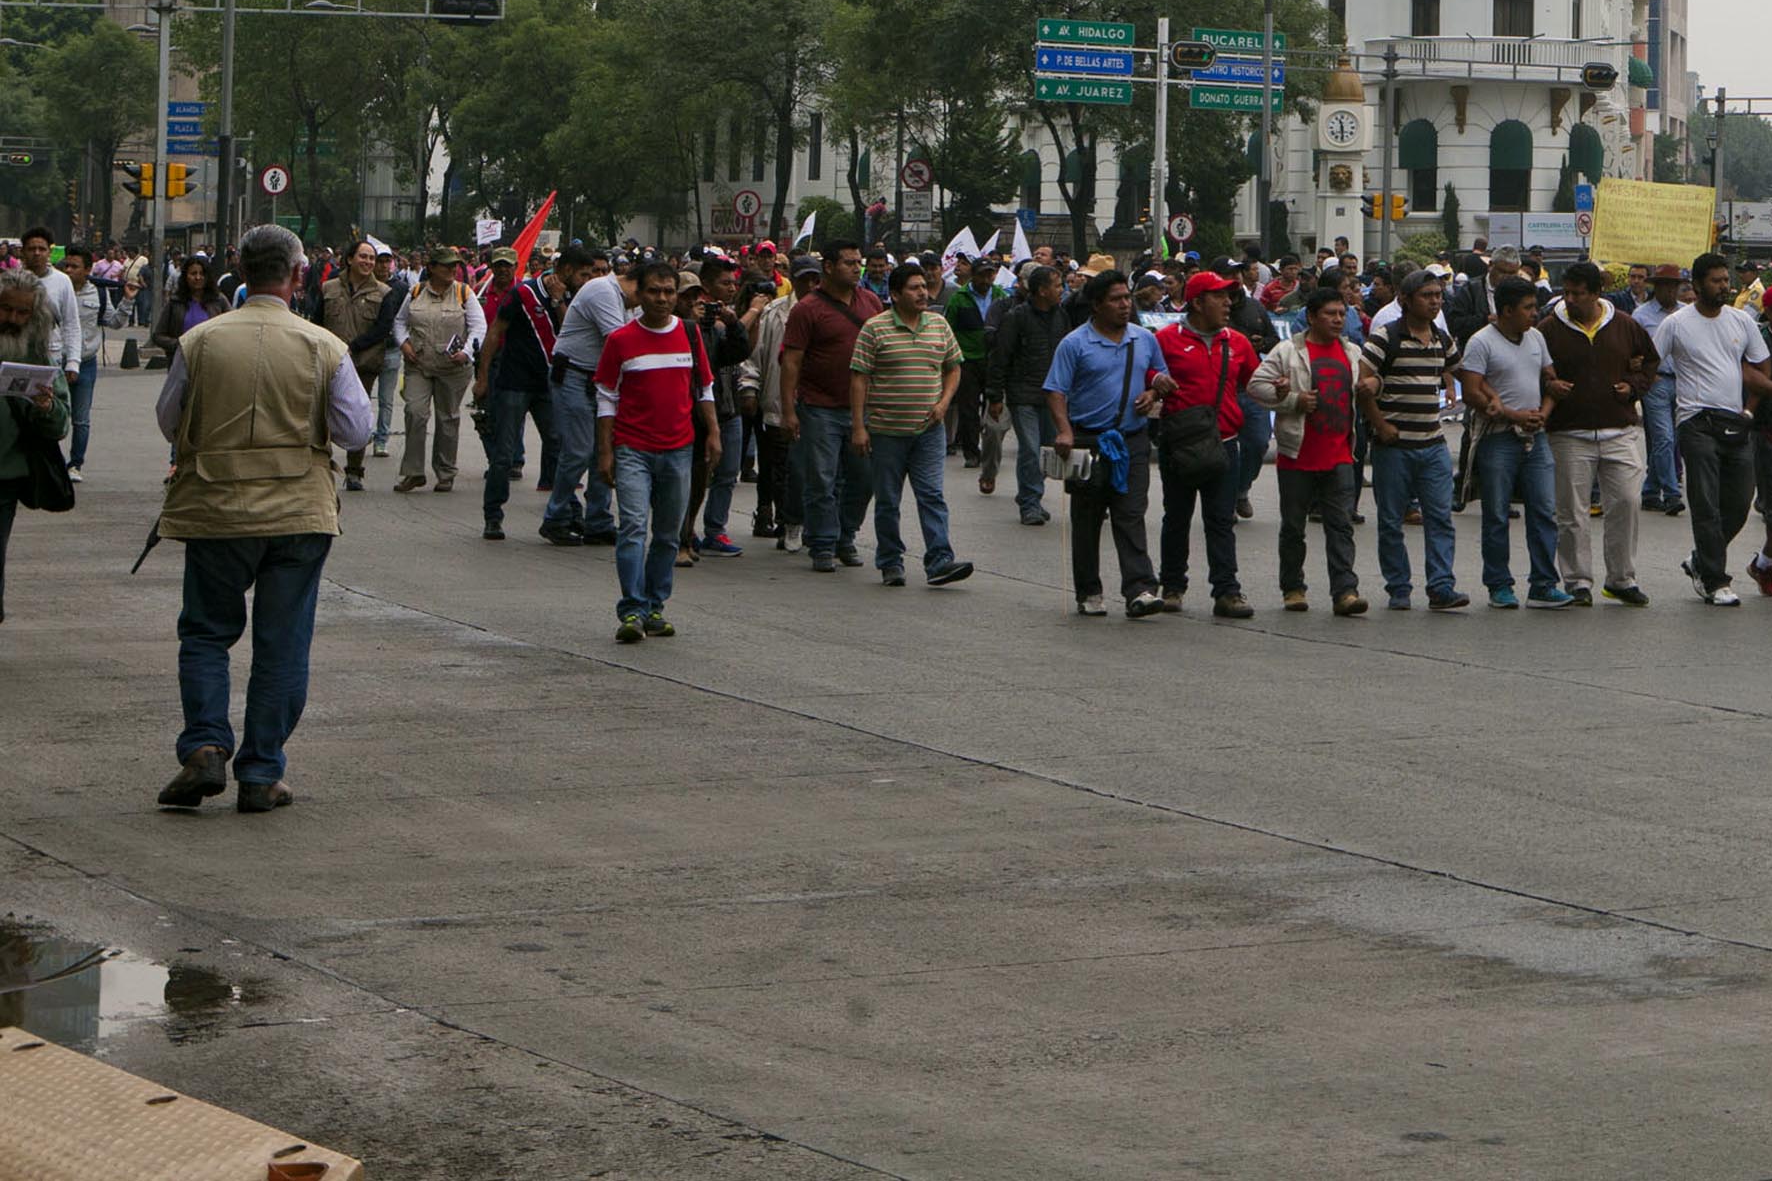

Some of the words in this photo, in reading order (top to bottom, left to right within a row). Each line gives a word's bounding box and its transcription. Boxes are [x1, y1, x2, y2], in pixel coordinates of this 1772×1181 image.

[1078, 27, 1126, 40] HIDALGO
[1202, 34, 1264, 48] BUCAREL
[1075, 56, 1101, 68] BELLAS
[1103, 58, 1125, 69] ARTES
[1056, 85, 1071, 96] AV.
[1076, 86, 1124, 99] JUAREZ
[1199, 93, 1230, 105] DONATO
